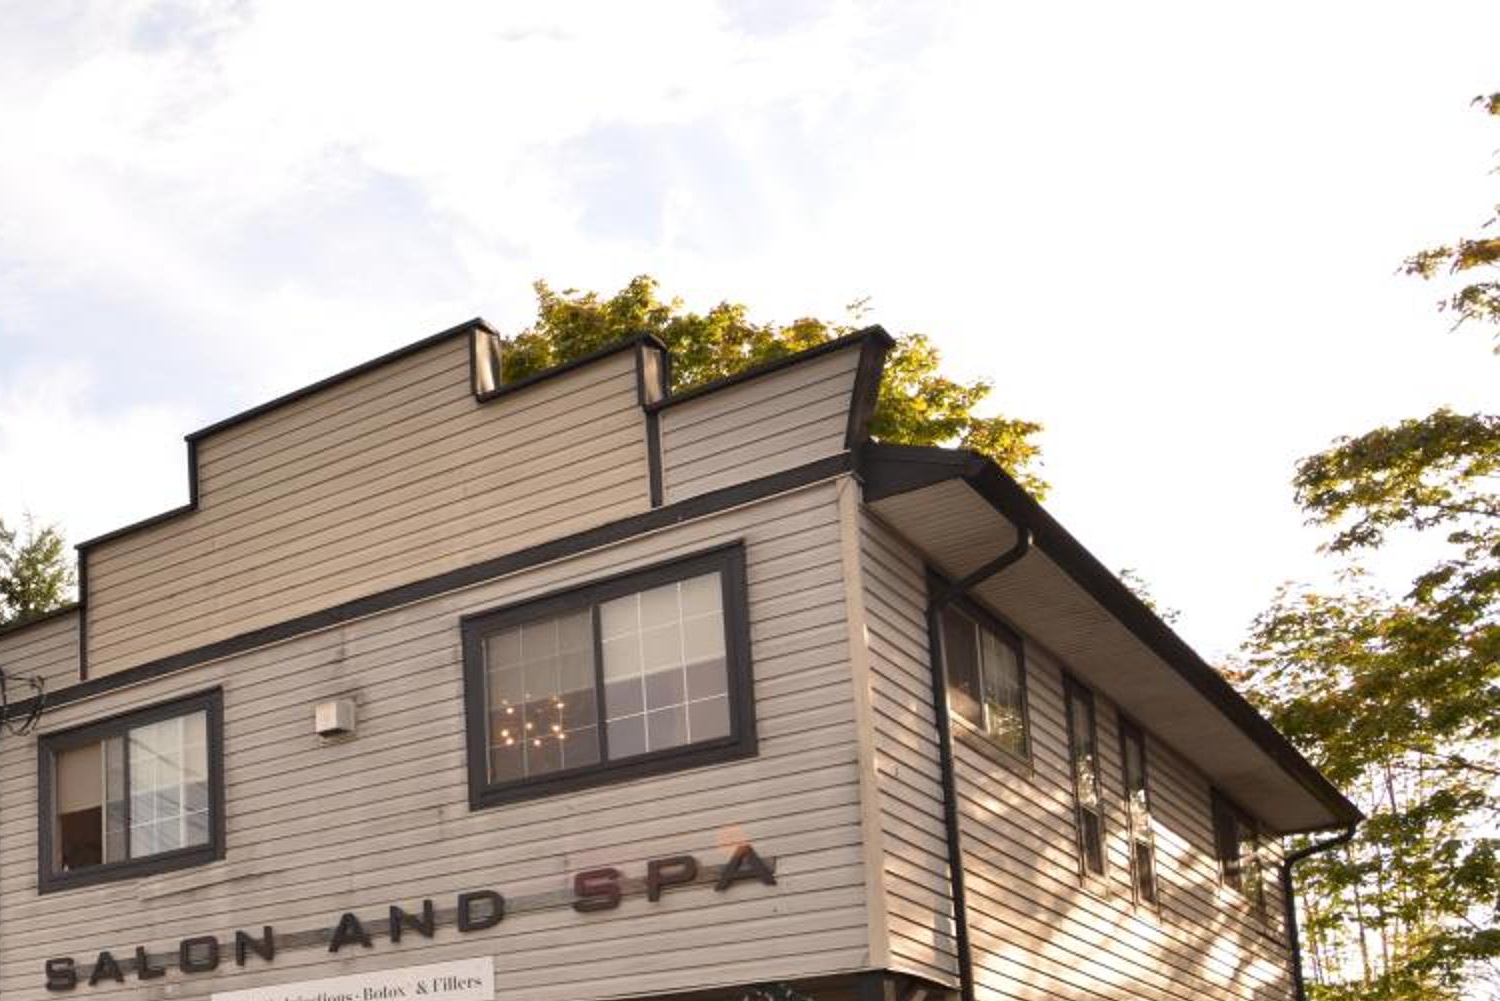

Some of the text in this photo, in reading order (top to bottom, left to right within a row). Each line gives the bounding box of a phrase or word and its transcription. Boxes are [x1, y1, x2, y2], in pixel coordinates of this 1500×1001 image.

[45, 844, 777, 991] SALON AND SPA
[415, 980, 428, 996] &
[433, 975, 482, 993] Fillers
